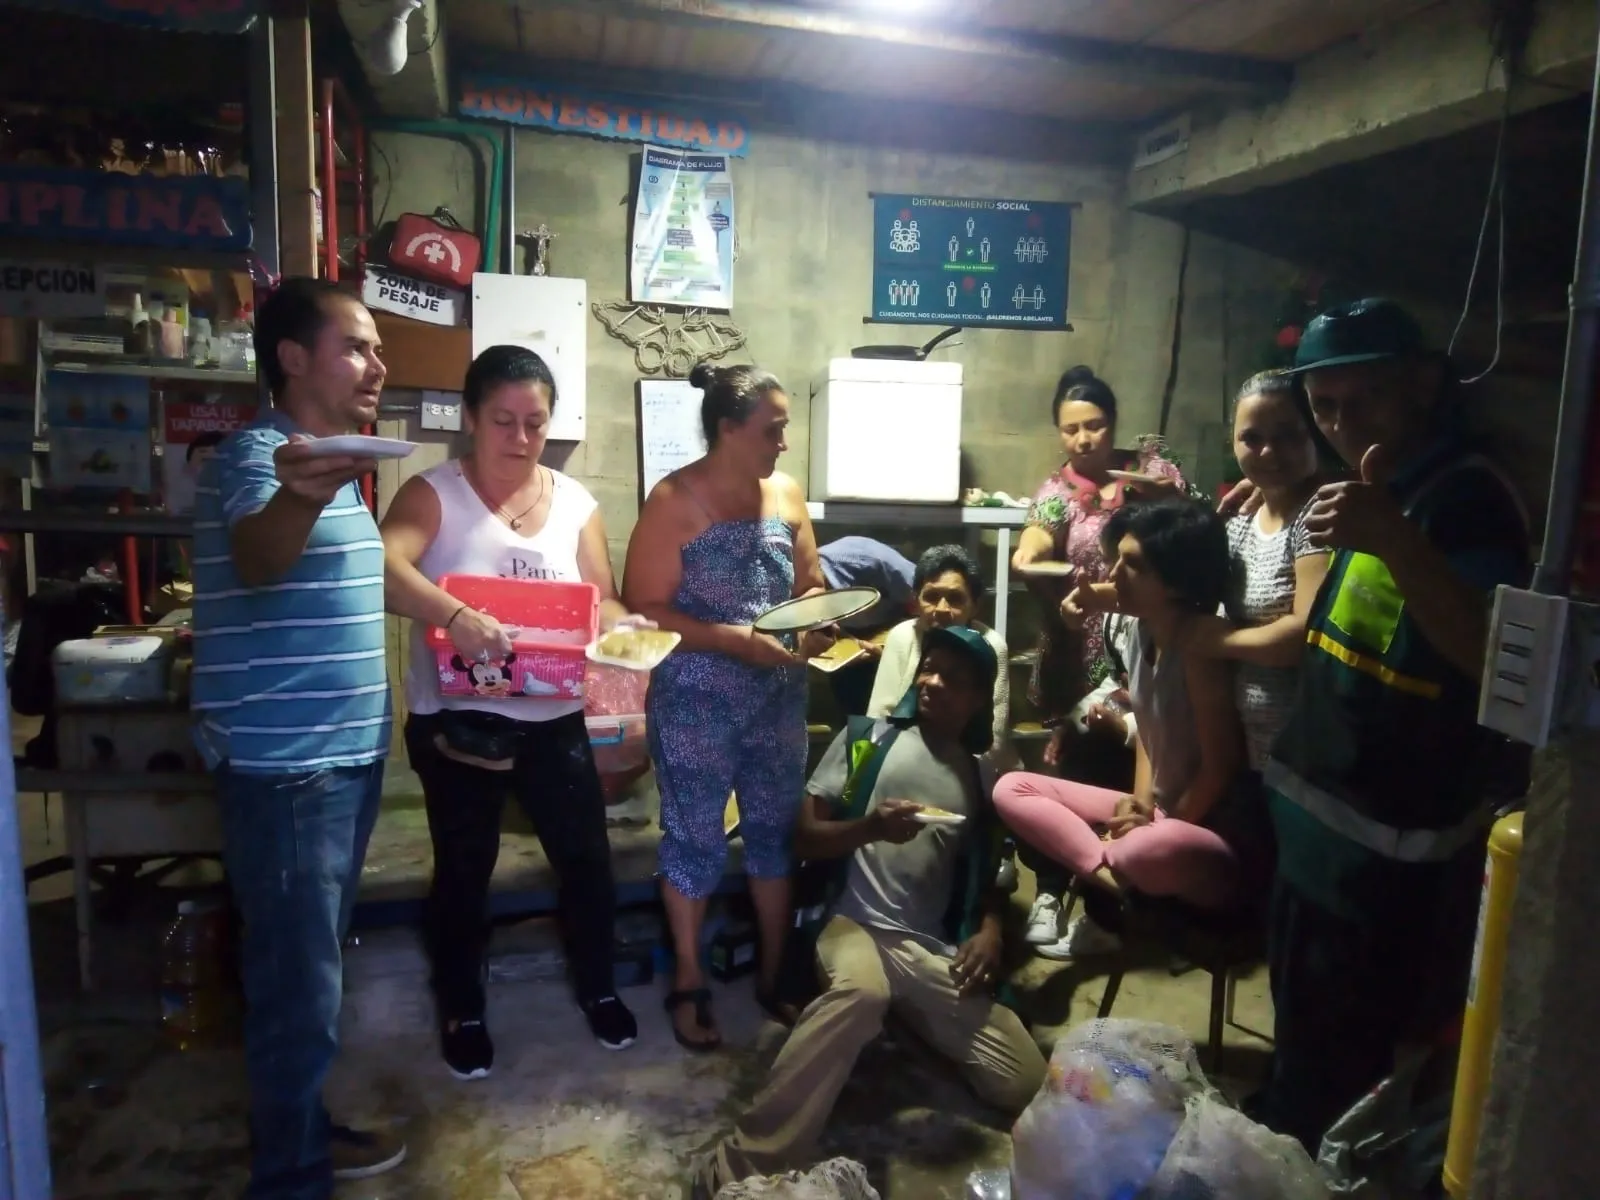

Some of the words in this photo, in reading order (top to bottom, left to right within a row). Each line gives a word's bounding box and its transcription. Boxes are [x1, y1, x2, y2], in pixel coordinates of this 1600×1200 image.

[461, 88, 745, 150] HONESTIDAD
[686, 160, 698, 168] DE
[912, 197, 995, 210] DISTANCIAMIENTO
[996, 201, 1031, 211] SOCIAL
[0, 265, 96, 295] EPCIÓN
[376, 274, 420, 295] ZONA
[426, 284, 446, 300] DE
[379, 286, 440, 312] PESAJE
[190, 405, 219, 419] USA
